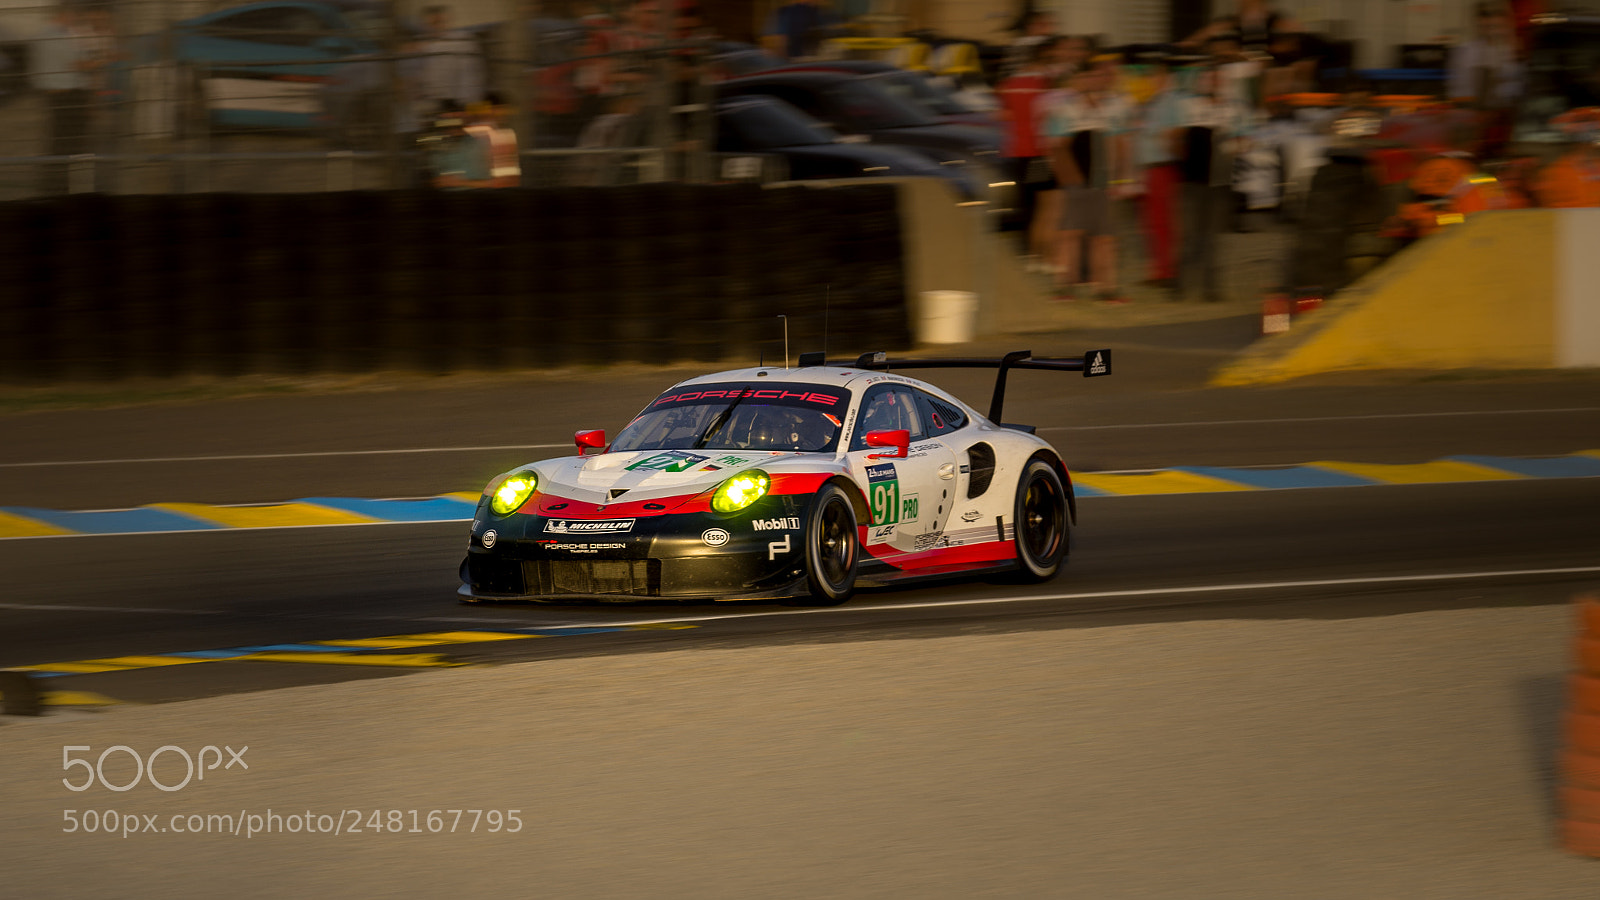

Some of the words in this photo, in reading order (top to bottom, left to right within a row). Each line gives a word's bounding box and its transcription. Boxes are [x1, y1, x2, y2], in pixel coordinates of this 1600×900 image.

[653, 389, 840, 408] PORSCHE
[874, 483, 895, 525] 91
[903, 497, 918, 520] PRO
[569, 521, 632, 530] MICHELIN
[752, 517, 788, 531] Mobil
[706, 532, 724, 541] Esso
